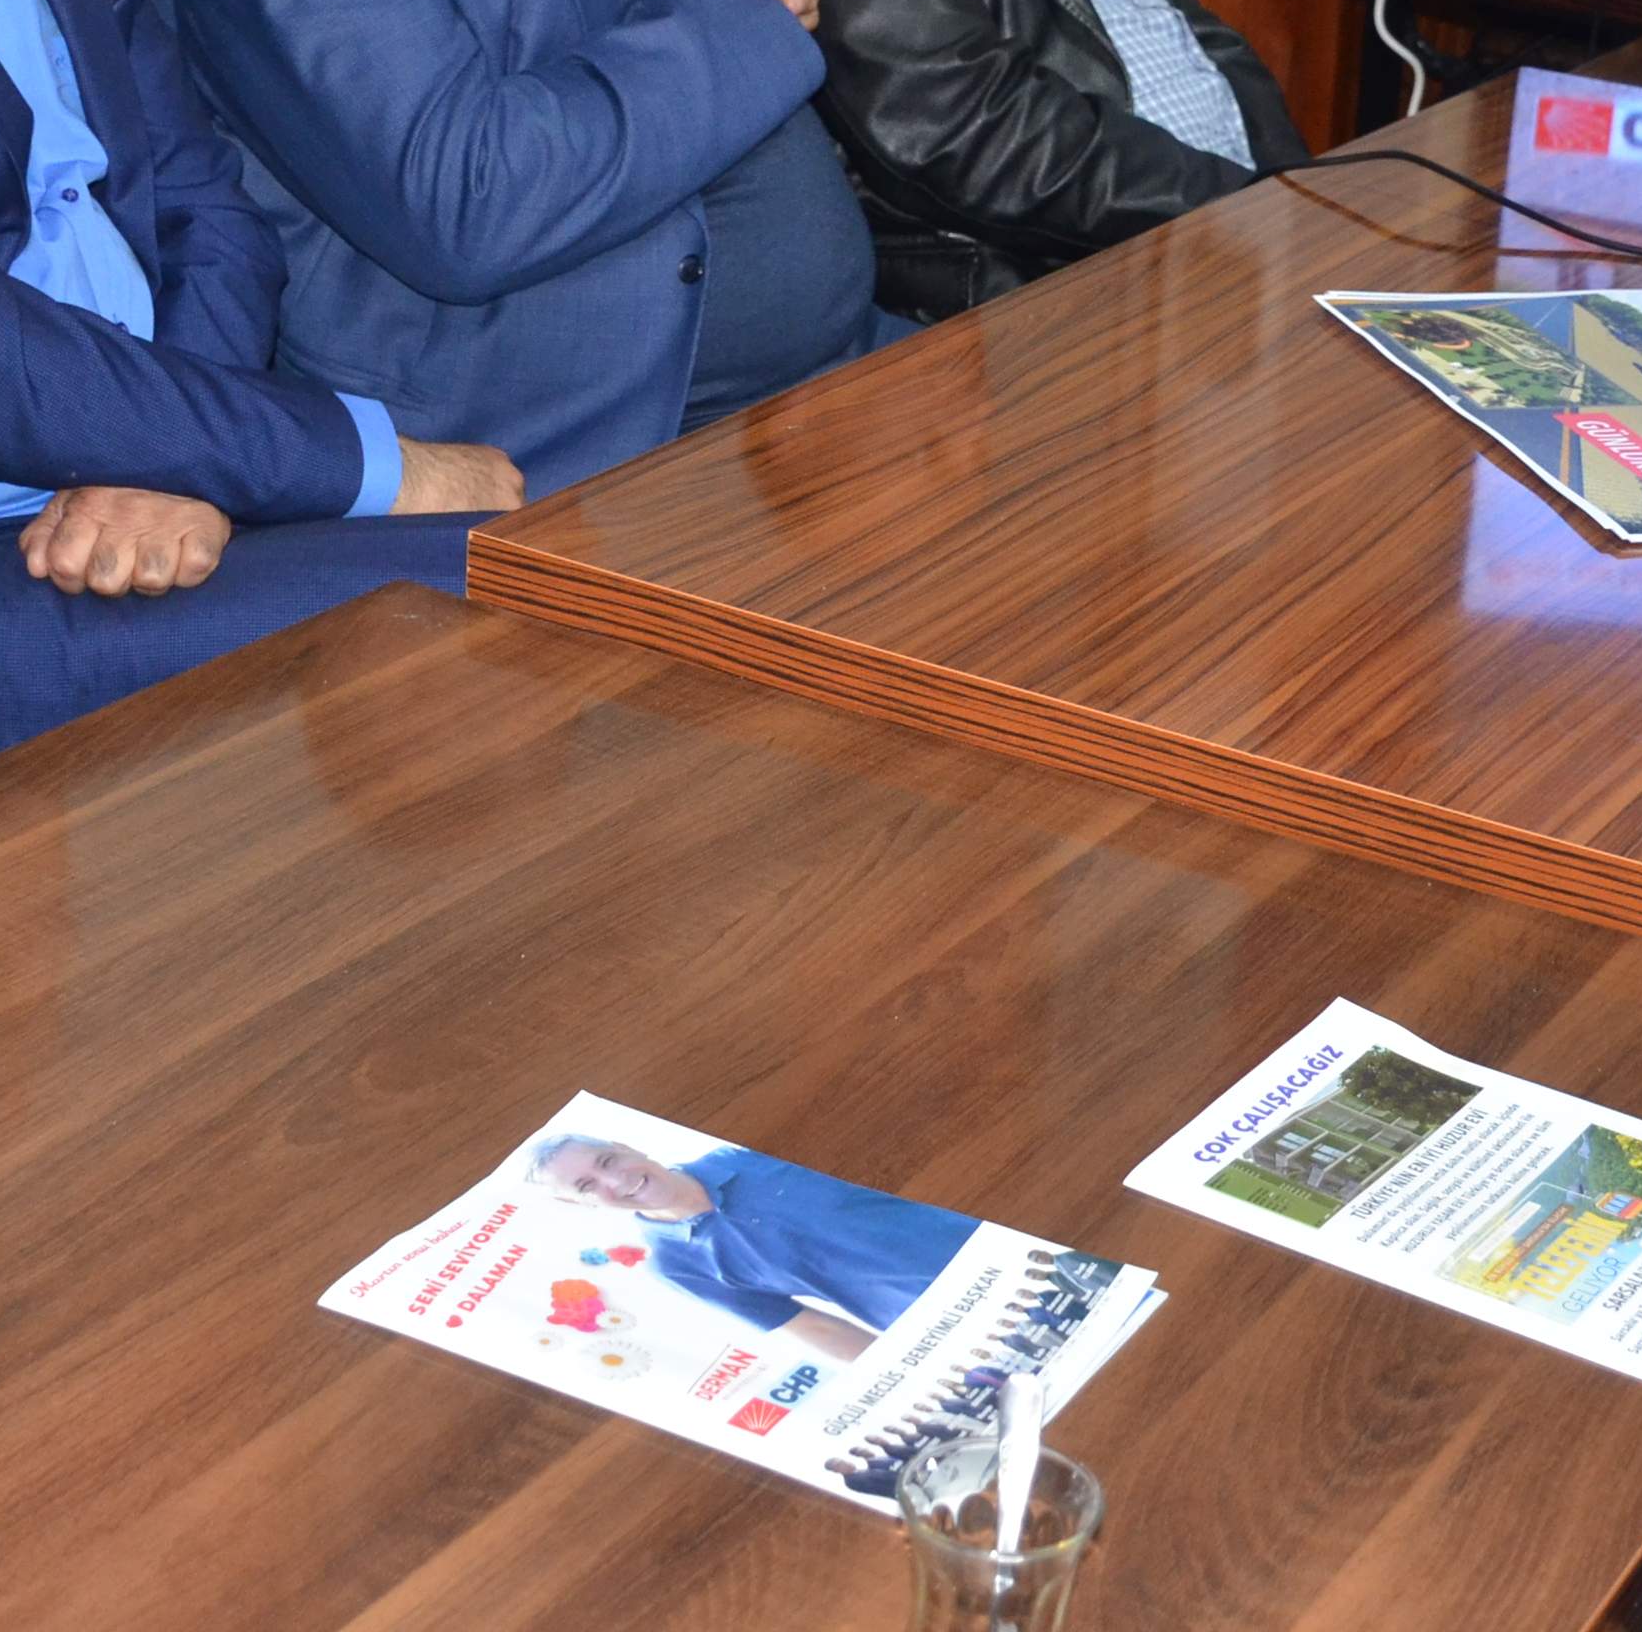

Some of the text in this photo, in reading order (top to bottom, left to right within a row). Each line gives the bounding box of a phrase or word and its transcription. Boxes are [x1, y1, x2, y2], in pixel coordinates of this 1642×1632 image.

[1194, 1045, 1343, 1163] ÇOK ÇALIŞACAĞIZ
[1464, 1107, 1488, 1124] EVİ
[1416, 1146, 1443, 1162] İYİ
[1434, 1123, 1474, 1151] HUZUR
[1408, 1160, 1429, 1173] EN
[408, 1203, 518, 1316] SENİ SEVİYORUM
[457, 1243, 529, 1312] DALAMAN
[823, 1402, 868, 1436] GÜÇLÜ
[858, 1368, 906, 1407] MECLİS
[906, 1310, 962, 1368] DENEYİMLİ
[954, 1266, 1003, 1315] BAŞKAN
[695, 1348, 758, 1402] DERMAN
[769, 1365, 819, 1404] CHP
